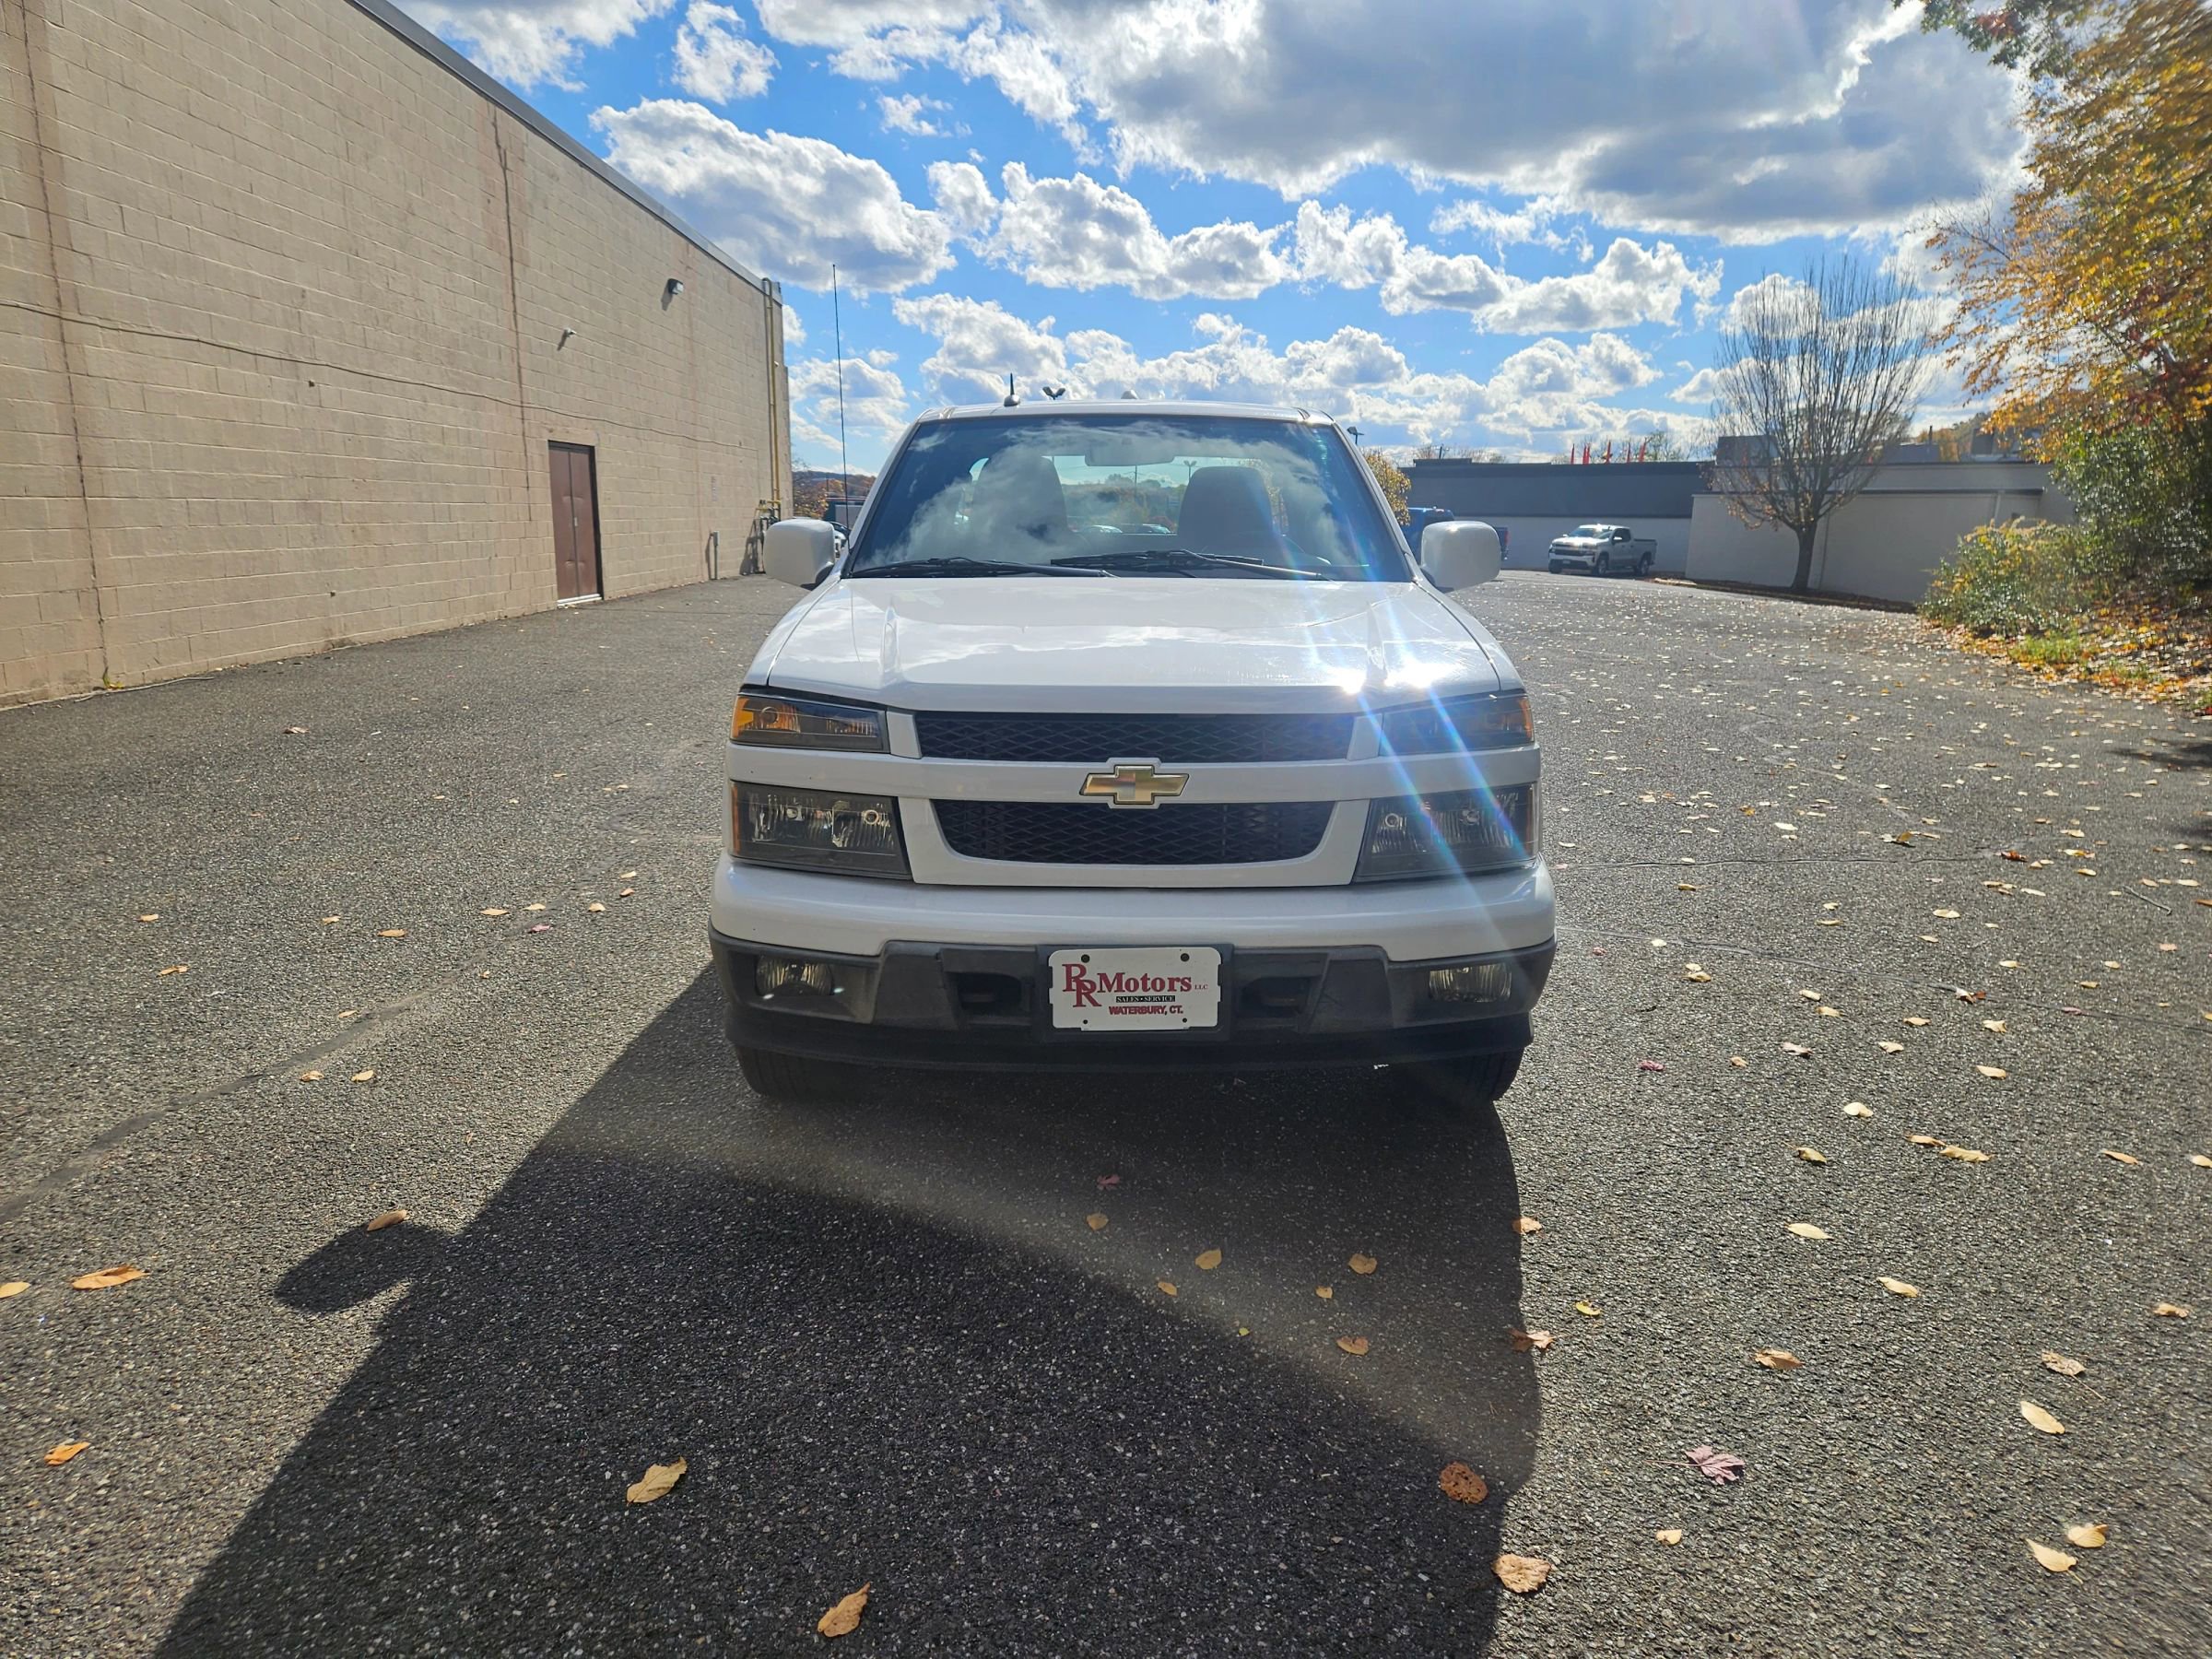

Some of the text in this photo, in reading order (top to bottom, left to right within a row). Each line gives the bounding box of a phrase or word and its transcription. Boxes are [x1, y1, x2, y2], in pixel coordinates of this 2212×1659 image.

[1097, 971, 1193, 993] Motors
[1108, 1005, 1183, 1016] WATERBURY, CT.
